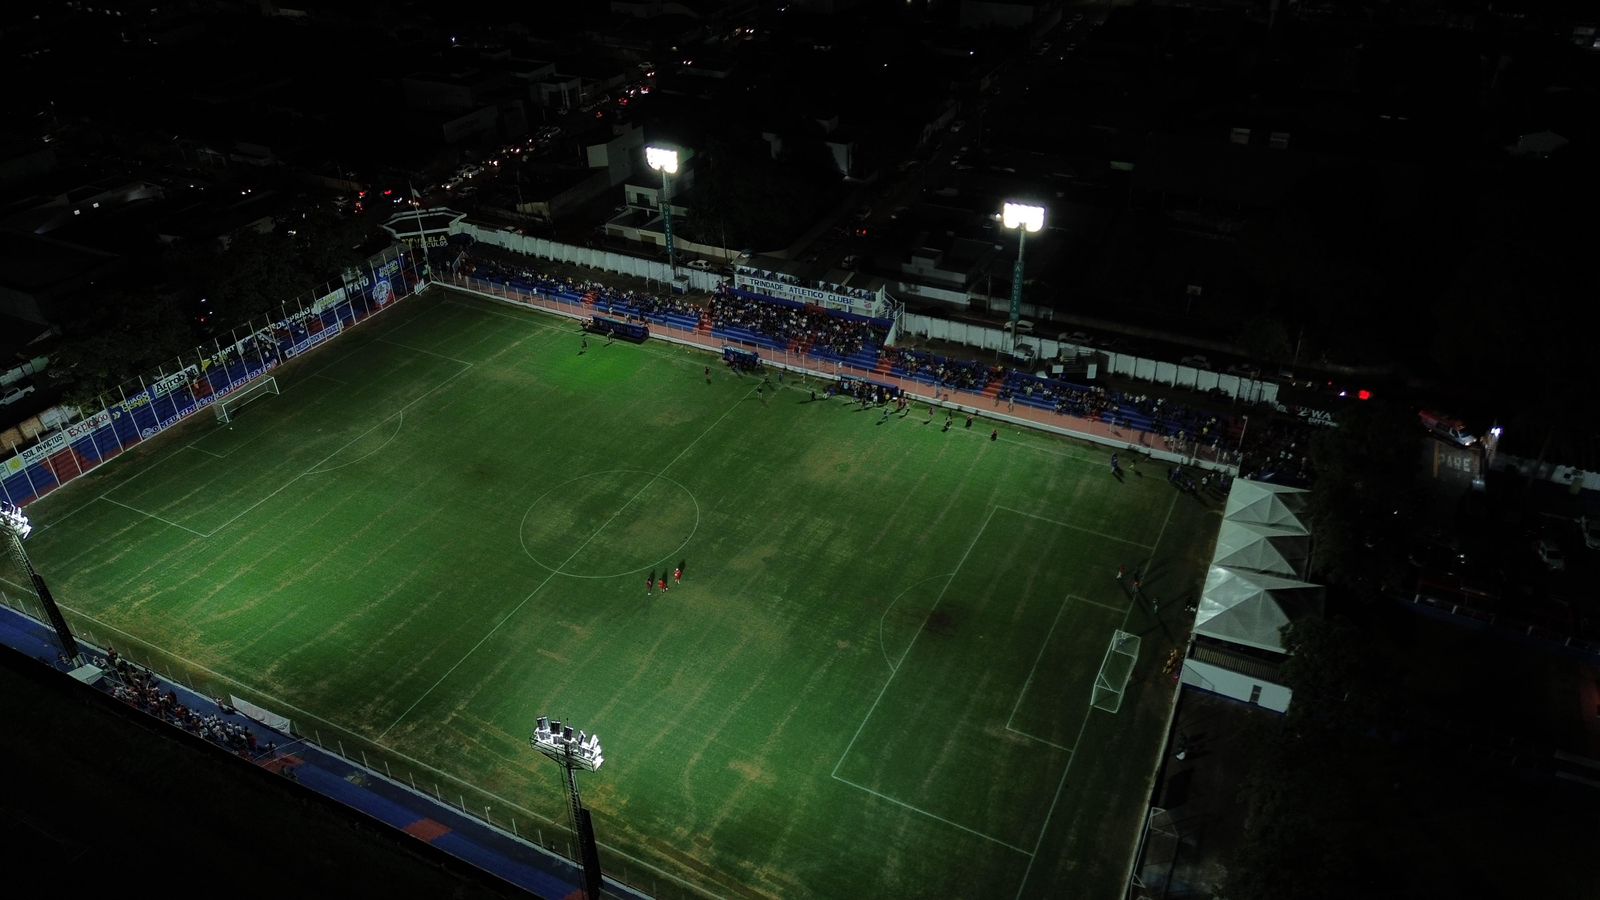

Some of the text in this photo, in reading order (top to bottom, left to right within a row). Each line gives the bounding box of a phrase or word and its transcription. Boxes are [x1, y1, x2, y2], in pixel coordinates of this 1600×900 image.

[749, 278, 855, 306] TRINDADE ATLETICO CLUBE
[159, 415, 177, 428] MEU
[22, 448, 36, 459] SOL
[35, 435, 63, 452] INVICTUS
